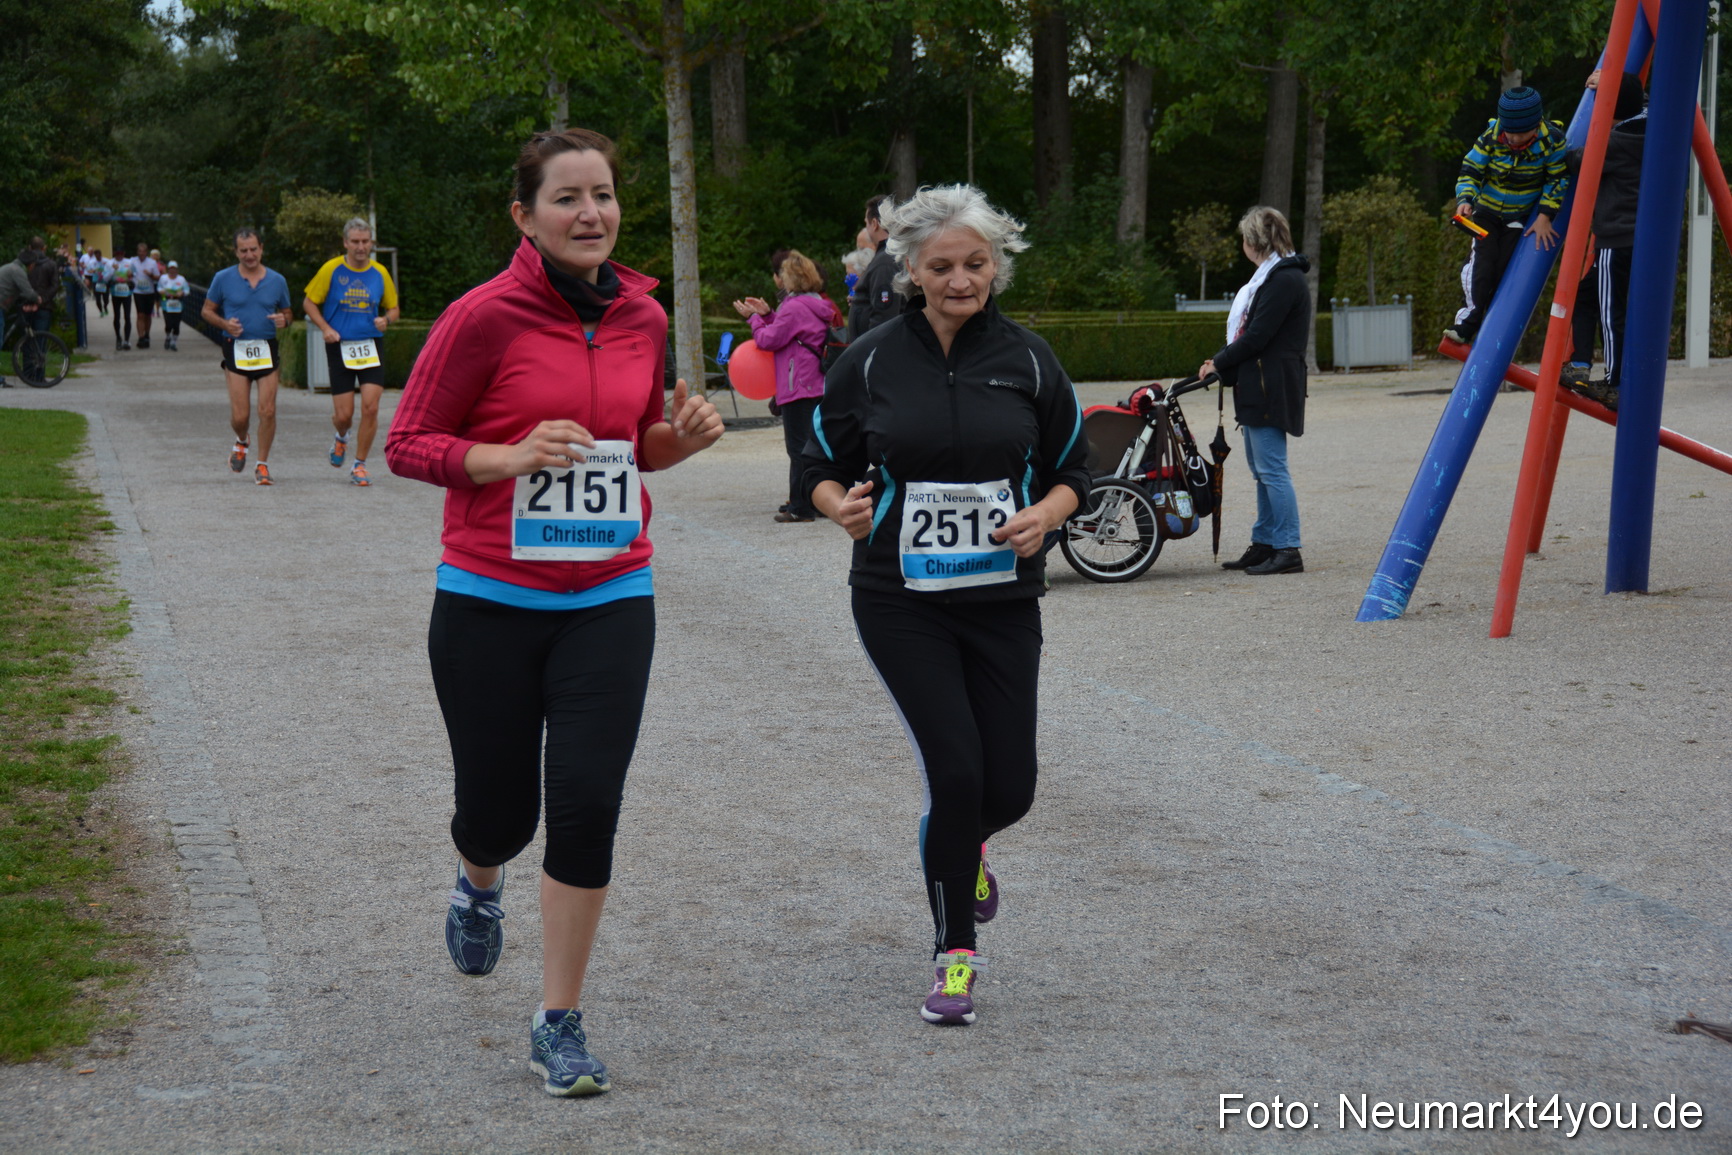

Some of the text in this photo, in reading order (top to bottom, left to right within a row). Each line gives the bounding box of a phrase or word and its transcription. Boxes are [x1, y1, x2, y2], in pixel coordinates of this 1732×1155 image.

[246, 346, 260, 358] 60
[349, 345, 370, 358] 315
[528, 470, 628, 513] 2151
[908, 493, 940, 503] PARTL
[542, 525, 616, 543] Christine
[912, 509, 1008, 547] 2513
[926, 559, 993, 575] Christine
